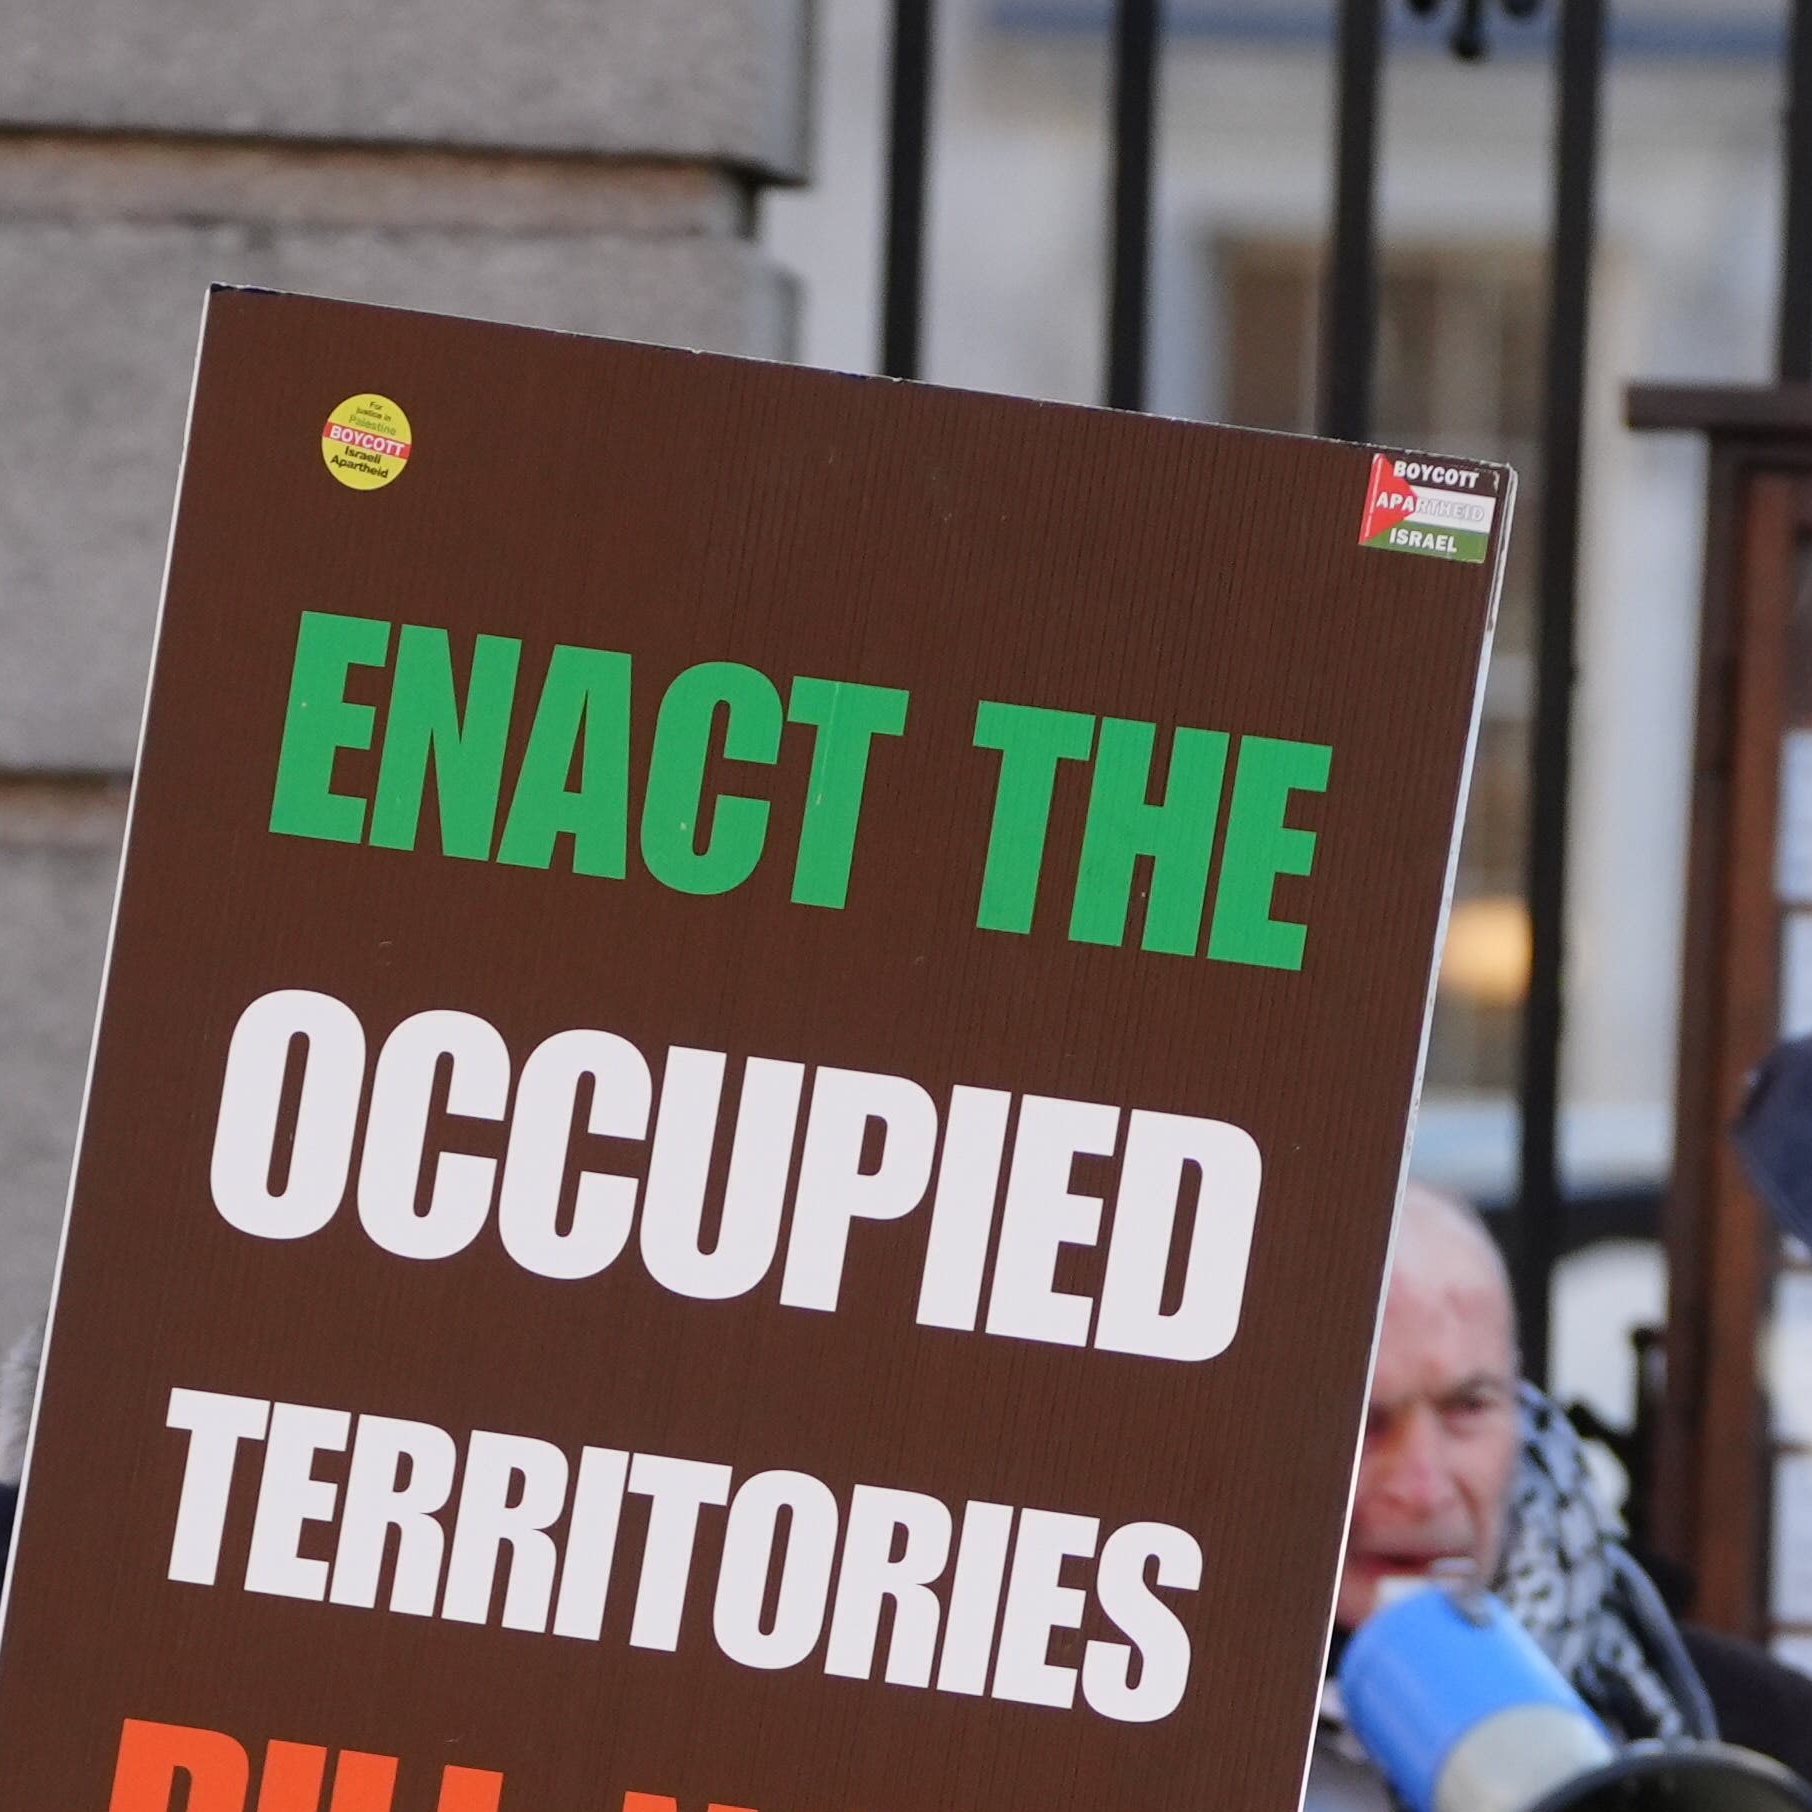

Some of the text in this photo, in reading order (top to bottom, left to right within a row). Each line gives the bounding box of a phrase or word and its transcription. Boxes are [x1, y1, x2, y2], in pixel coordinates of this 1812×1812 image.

[349, 414, 397, 436] Palestine
[330, 425, 405, 456] BOYCOTT
[344, 446, 382, 464] Israeli
[330, 455, 389, 478] Apartheid
[1393, 460, 1480, 488] BOYCOTT
[1376, 491, 1485, 521] APARTHEID
[1389, 527, 1458, 553] ISRAEL
[269, 611, 1332, 970] ENACT THE
[211, 990, 1261, 1361] OCCUPIED
[167, 1388, 1202, 1722] TERRITORIES
